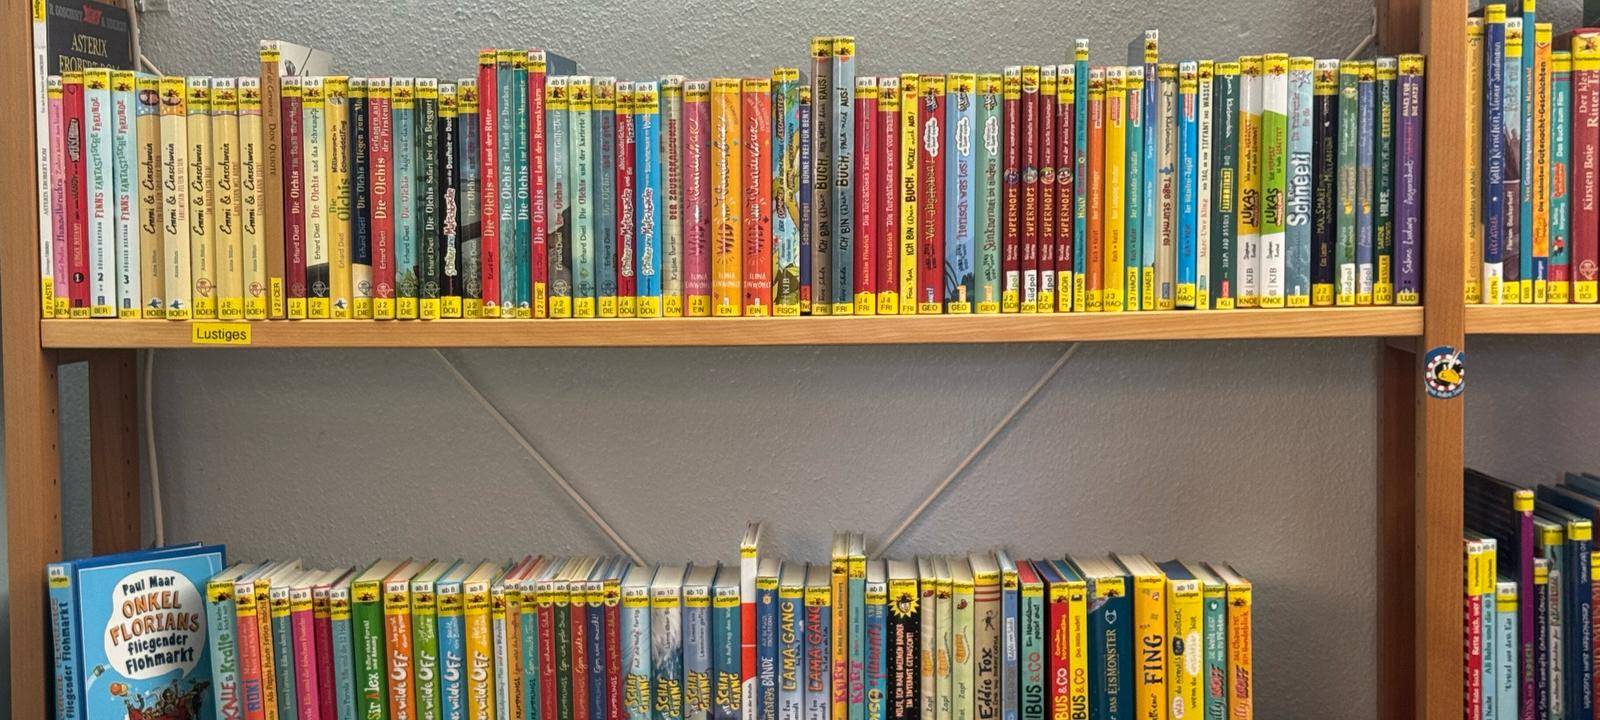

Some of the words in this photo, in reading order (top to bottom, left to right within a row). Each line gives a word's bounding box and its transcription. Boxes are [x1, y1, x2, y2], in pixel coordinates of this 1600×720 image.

[71, 33, 108, 57] ASTERIX
[818, 74, 829, 100] RAUS!
[837, 87, 849, 106] AUS!
[91, 97, 102, 131] FREUNDE
[117, 100, 128, 133] FREUNDE
[1538, 61, 1548, 165] Gutenacht-Geschichten
[1579, 94, 1588, 113] Der
[802, 129, 810, 142] FÜR
[91, 132, 103, 190] FANTASTISCHE
[117, 136, 129, 192] FANTASTISCHE
[802, 144, 810, 159] FREI
[1584, 144, 1595, 168] Boie
[142, 143, 155, 191] Einschwein
[165, 143, 176, 191] Einschwein
[193, 144, 204, 192] Einschwein
[220, 143, 231, 191] Einschwein
[243, 143, 254, 191] Einschwein
[356, 167, 365, 192] Olchis
[375, 157, 387, 195] Olchis
[802, 161, 810, 183] BÜHNE
[816, 155, 829, 190] BUCH,
[836, 152, 850, 187] BUCH,
[290, 170, 300, 198] Olchis
[311, 175, 320, 202] Olchis
[502, 165, 512, 199] Olchis
[518, 166, 528, 199] Olchis
[536, 176, 544, 186] im
[578, 179, 587, 205] Olchis
[905, 173, 916, 202] BUCH,
[1583, 172, 1594, 210] Kirsten
[95, 192, 105, 218] FINNS
[121, 194, 130, 220] FINNS
[145, 196, 154, 205] &
[166, 196, 175, 205] &
[194, 197, 203, 206] &
[222, 196, 231, 205] &
[245, 196, 254, 205] &
[292, 201, 300, 214] Die
[312, 204, 320, 218] Die
[338, 178, 351, 221] Olchis
[357, 195, 366, 208] Die
[375, 198, 388, 219] Die
[425, 187, 434, 213] Olchis
[484, 182, 495, 216] Olchis
[503, 203, 512, 220] Die
[519, 203, 529, 220] Die
[534, 189, 545, 222] Olchis
[1027, 187, 1036, 237] SUPERMOPS
[1242, 189, 1256, 225] LUKAS
[1265, 187, 1279, 224] LUKAS
[144, 208, 156, 234] Emmi
[166, 209, 177, 235] Emmi
[194, 210, 205, 236] Emmi
[221, 209, 232, 235] Emmi
[245, 209, 256, 235] Emmi
[426, 216, 435, 230] Die
[579, 207, 587, 219] Die
[840, 217, 851, 233] BIN
[1009, 188, 1018, 237] SUPERMOPS
[1044, 188, 1053, 237] SUPERMOPS
[1061, 188, 1070, 237] SUPERMOPS
[485, 218, 495, 237] Die
[535, 225, 545, 244] Die
[819, 221, 830, 236] BIN
[906, 226, 915, 240] BIN
[1405, 216, 1416, 244] Ludwig
[819, 239, 829, 253] ICH
[840, 237, 849, 250] ICH
[906, 242, 914, 256] ICH
[1404, 249, 1413, 273] Sabine
[99, 272, 104, 282] 2
[125, 275, 129, 284] 3
[783, 278, 791, 293] KJB
[197, 328, 247, 341] Lustiges
[122, 580, 145, 596] Paul
[150, 576, 175, 587] Maar
[122, 591, 181, 618] ONKEL
[59, 602, 72, 660] Flohmarkt
[110, 613, 200, 646] FLORIANS
[128, 634, 188, 655] fliegender
[218, 634, 235, 673] Kralle
[782, 602, 797, 691] LAMA-GANG
[126, 647, 194, 674] Flohmarkt
[392, 650, 408, 680] UFF
[419, 651, 435, 680] UFF
[445, 651, 461, 681] UFF
[472, 651, 489, 681] UFF
[762, 656, 775, 686] BANDE
[979, 648, 992, 676] Fox
[1029, 652, 1041, 672] CO
[1107, 629, 1118, 694] EISMONSTER
[1144, 634, 1163, 684] FING
[366, 672, 380, 699] Alex
[687, 669, 700, 704] SCHAF
[717, 672, 730, 704] SCHAF
[834, 660, 847, 703] KURT
[850, 660, 864, 703] KURT
[1030, 673, 1041, 682] &
[1057, 668, 1067, 685] CO
[1075, 668, 1085, 684] CO
[66, 665, 75, 718] fliegender
[394, 681, 408, 708] wilde
[420, 682, 434, 708] wilde
[447, 682, 460, 709] wilde
[473, 682, 489, 708] wilde
[656, 678, 670, 710] SCHAF
[907, 698, 914, 708] IM
[979, 679, 993, 719] Eddie
[368, 702, 381, 720] Sir
